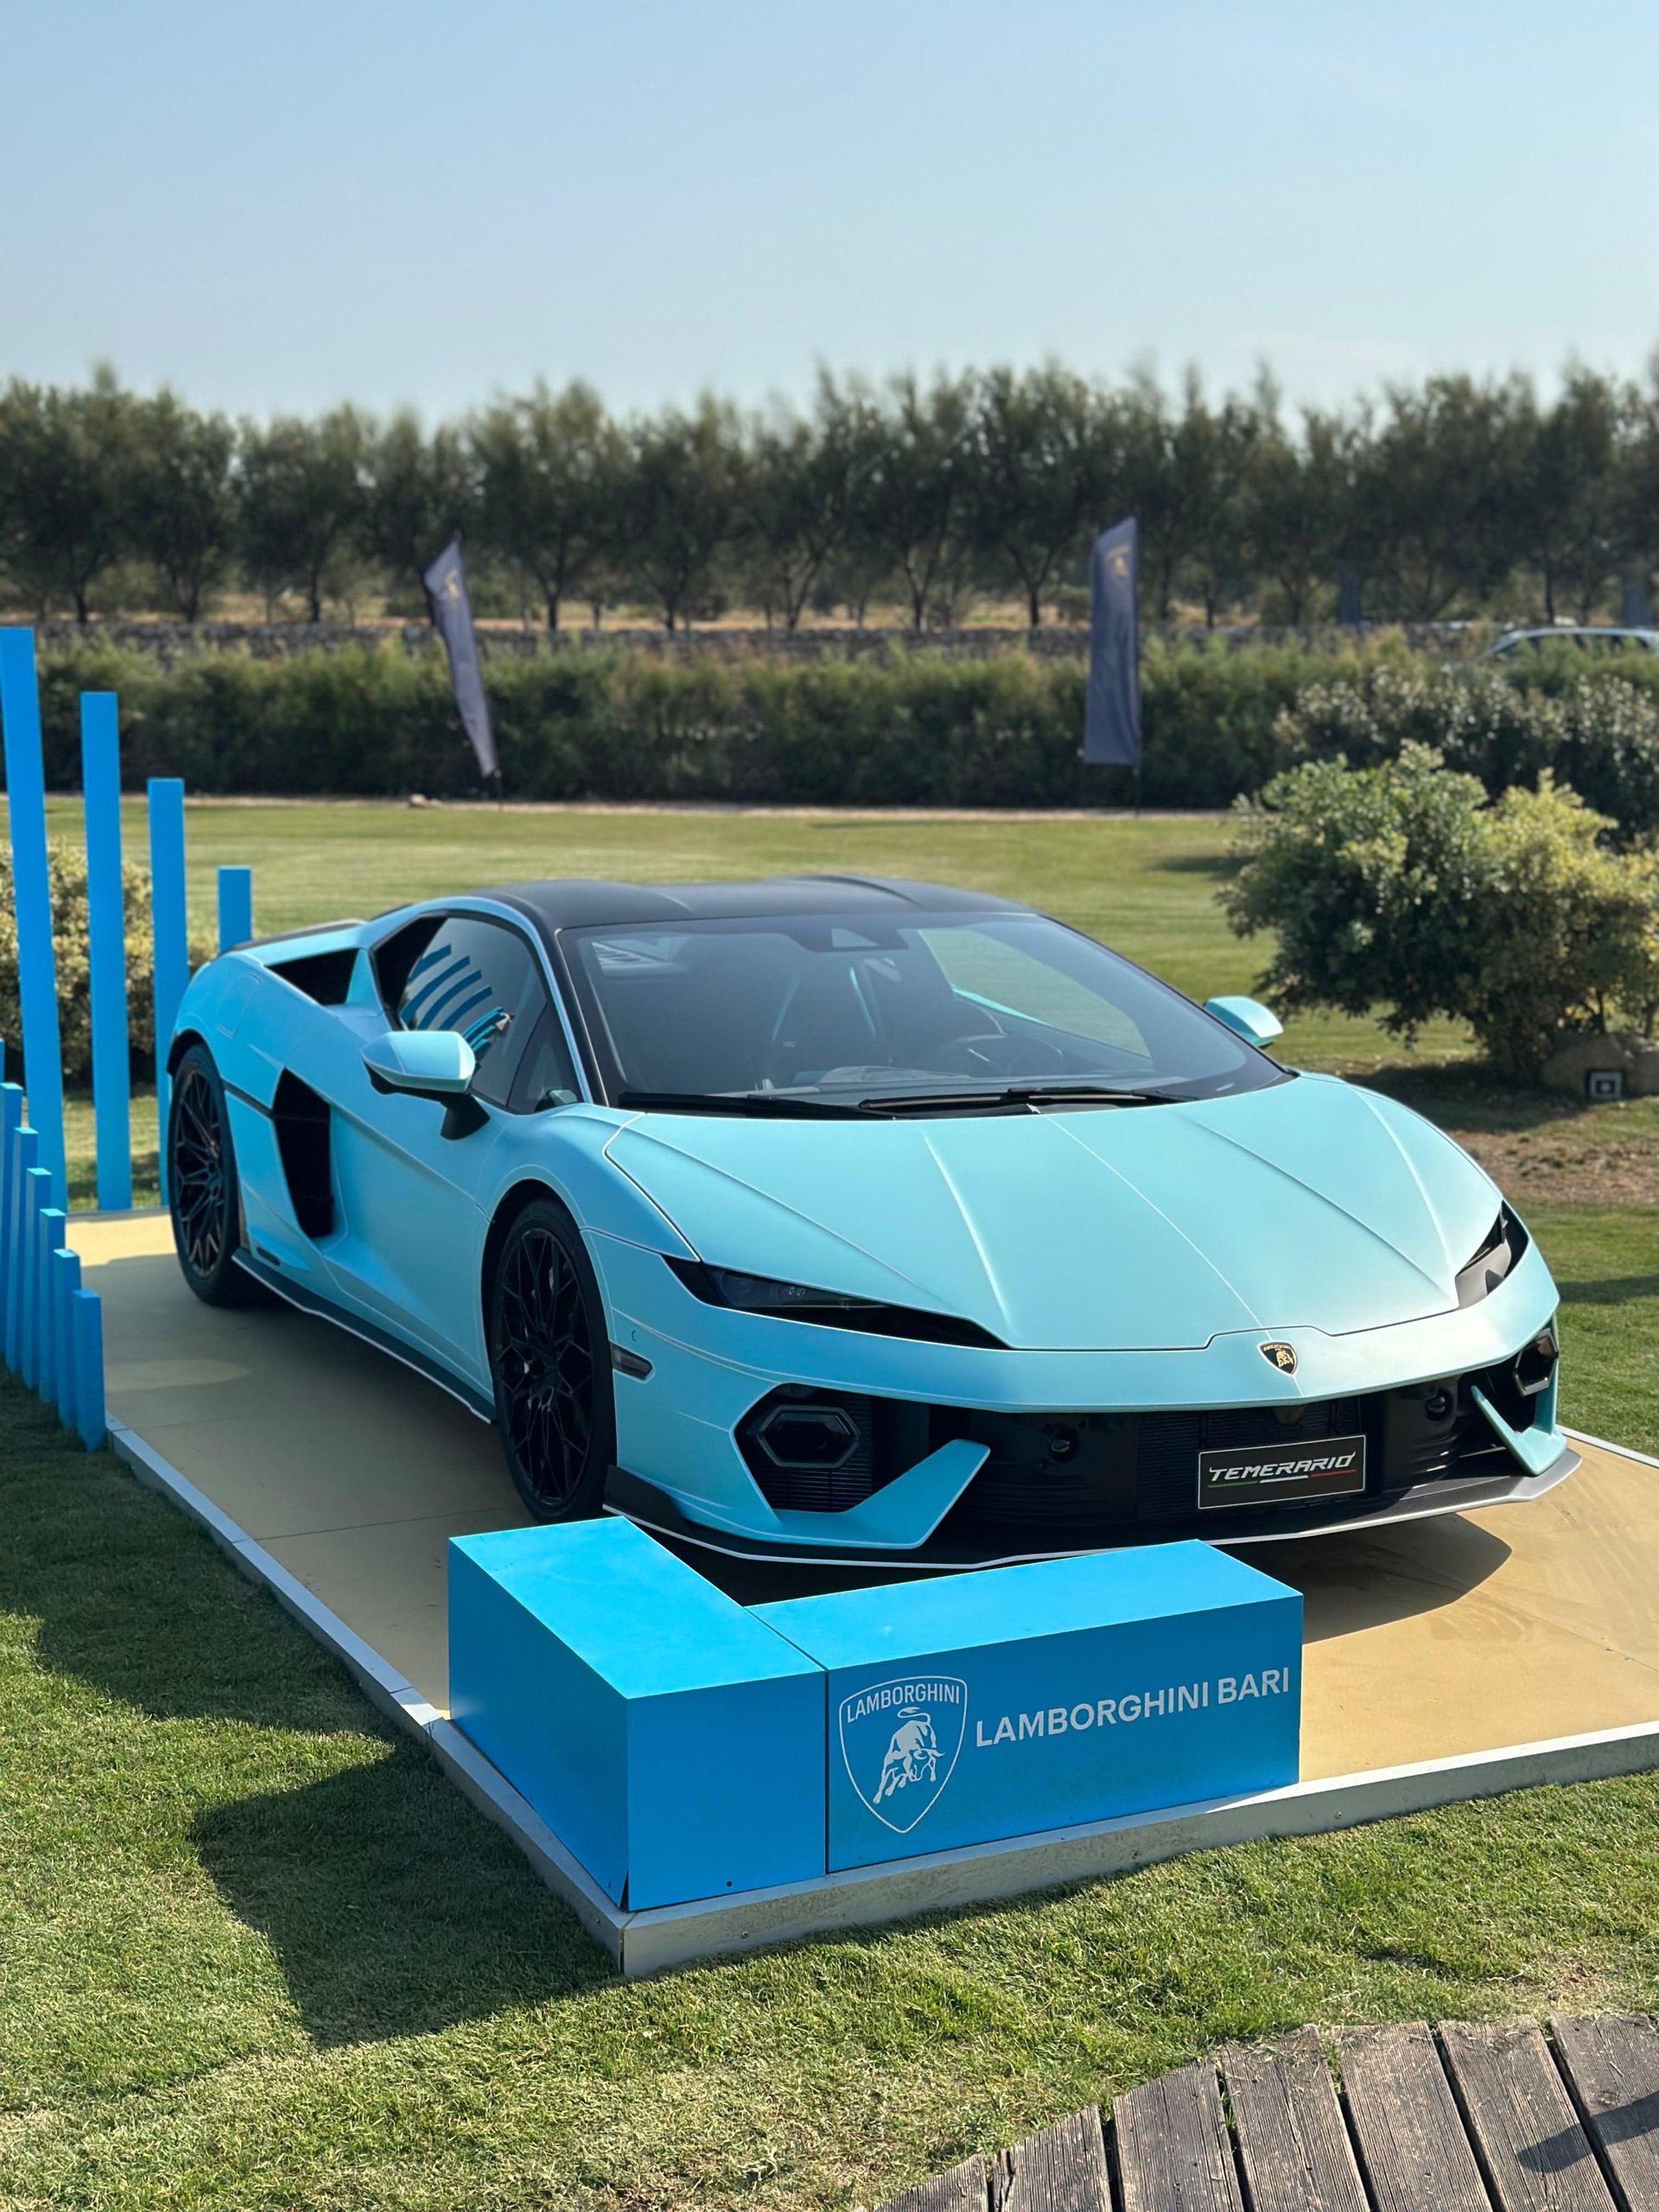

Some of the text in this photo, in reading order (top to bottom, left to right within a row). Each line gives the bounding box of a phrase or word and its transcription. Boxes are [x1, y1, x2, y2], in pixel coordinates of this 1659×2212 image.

[1209, 1452, 1357, 1482] TEMERARIO
[847, 1683, 960, 1723] LAMBORGHINI
[976, 1667, 1289, 1747] LAMBORGHINI BARI
